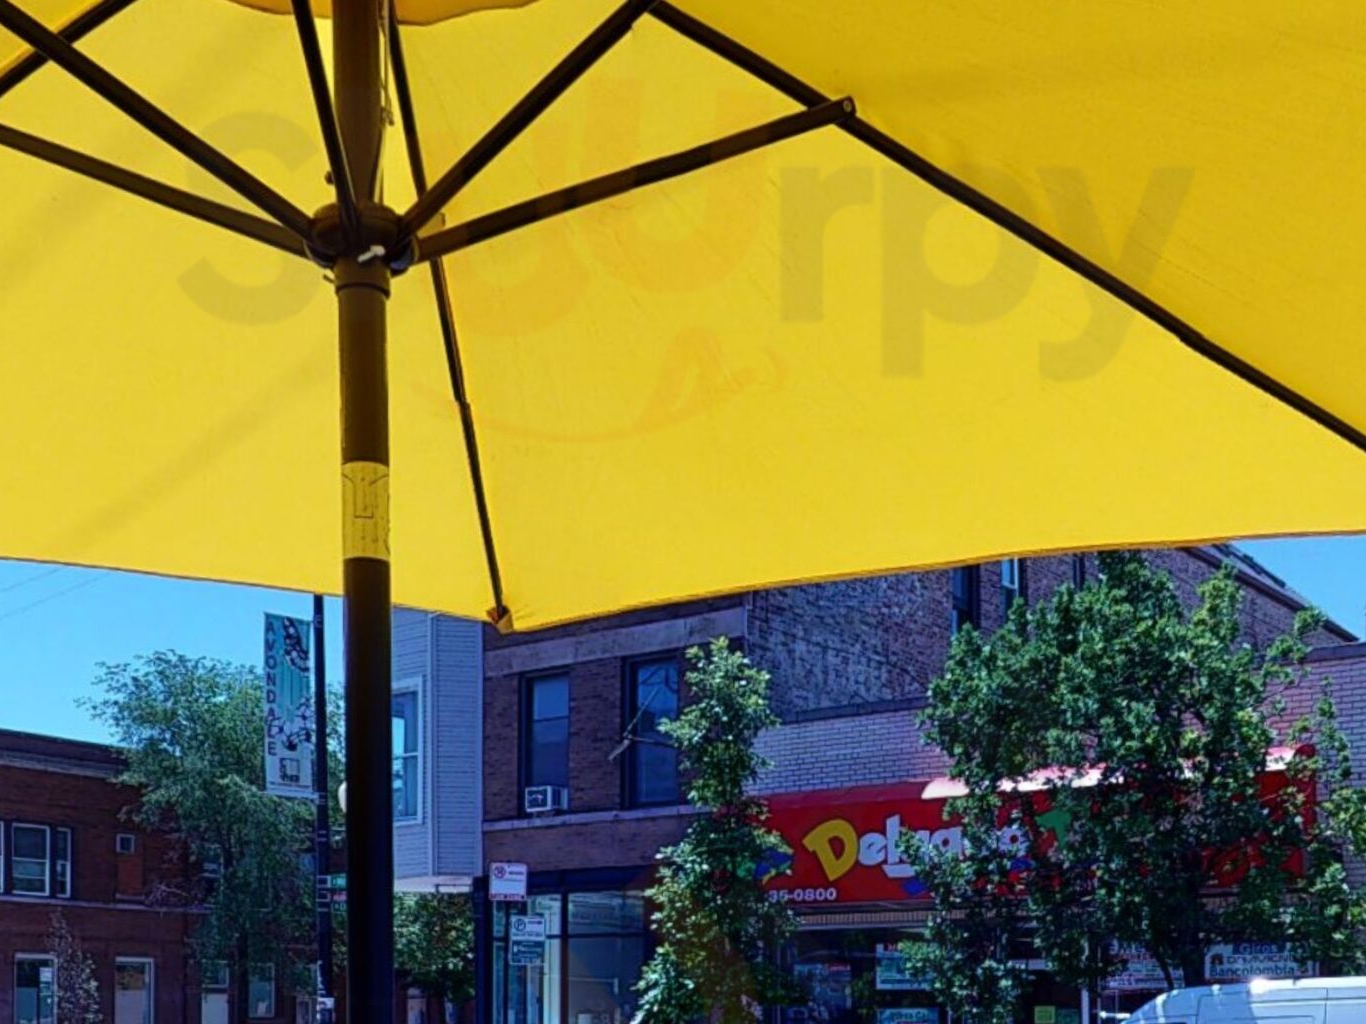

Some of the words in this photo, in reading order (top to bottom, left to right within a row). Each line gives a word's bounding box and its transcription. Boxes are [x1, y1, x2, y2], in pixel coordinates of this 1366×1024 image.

[266, 620, 278, 756] AVONDALE
[802, 814, 1031, 882] Delgao
[1210, 964, 1295, 977] Bancolombia
